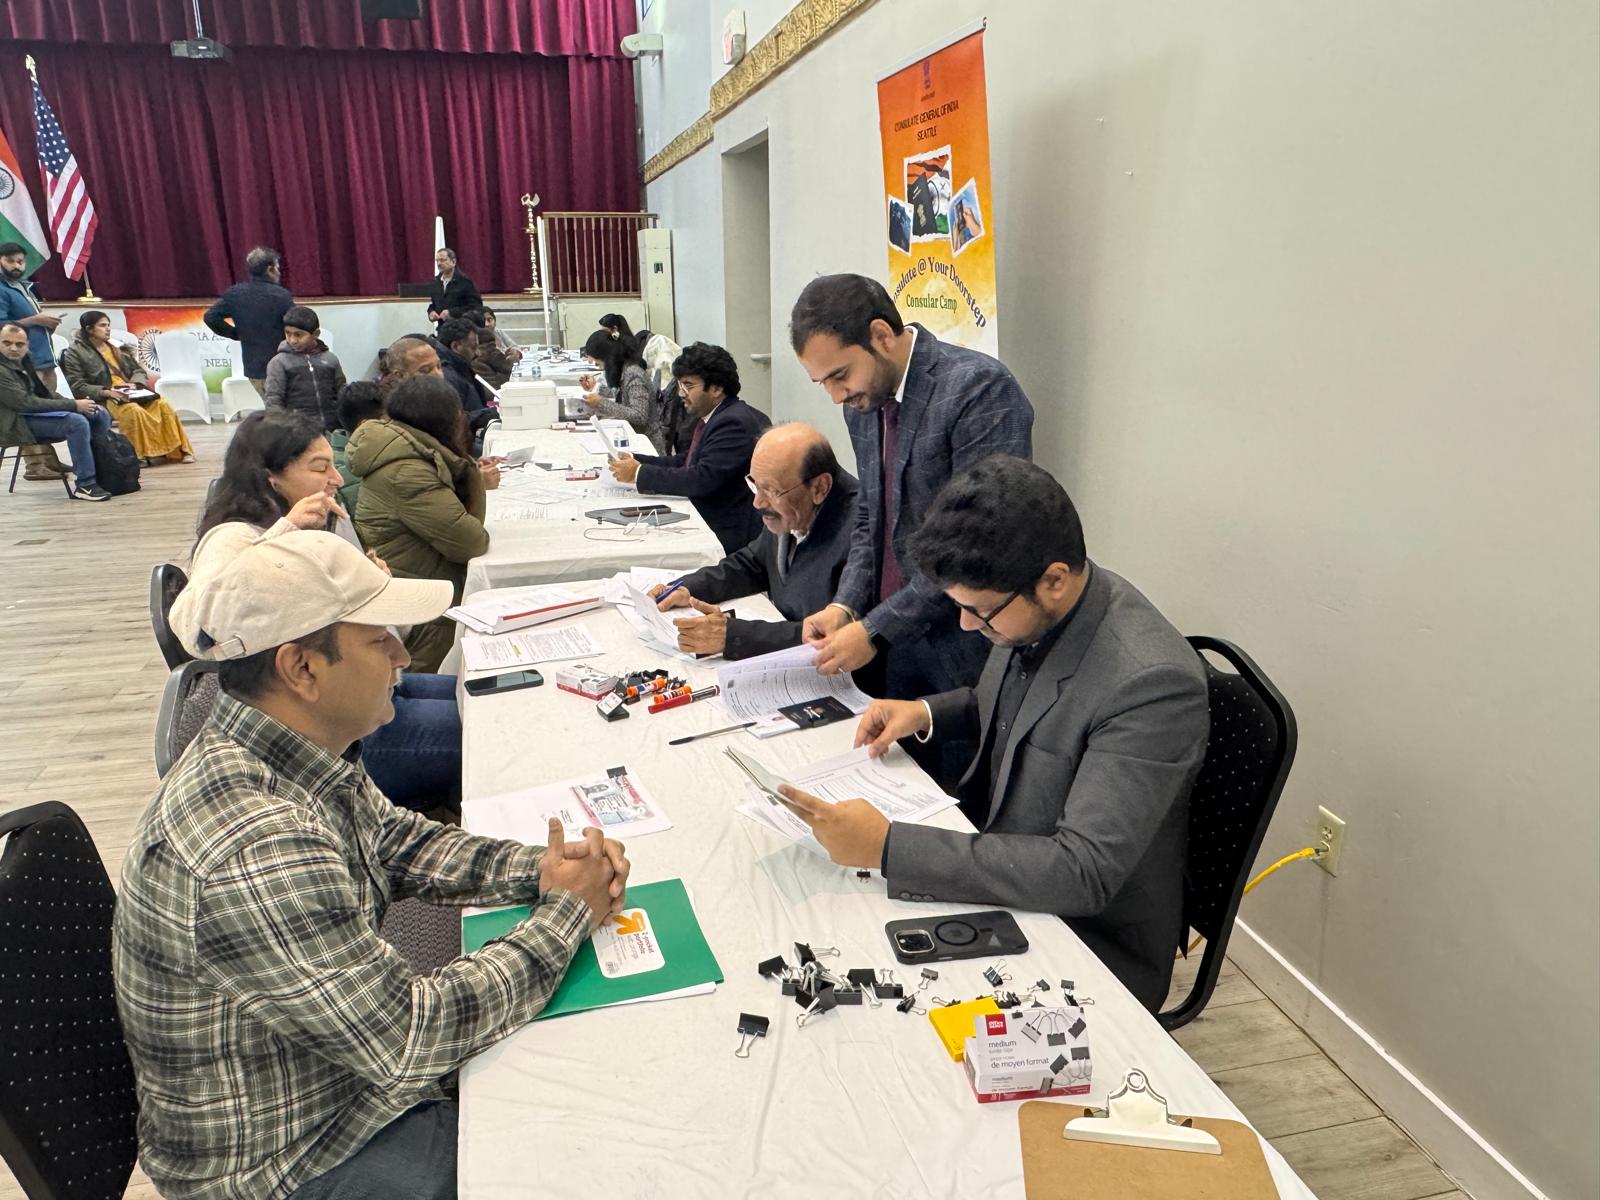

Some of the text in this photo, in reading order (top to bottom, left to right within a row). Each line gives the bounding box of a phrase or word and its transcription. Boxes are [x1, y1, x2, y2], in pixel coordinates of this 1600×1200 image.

[894, 114, 919, 132] CONSULATE
[920, 108, 941, 125] GENERAL
[946, 100, 959, 114] INDIA
[917, 126, 937, 141] SEATTLE
[918, 258, 927, 275] @
[928, 257, 949, 277] Your
[949, 264, 987, 328] Doorstep
[906, 293, 958, 313] Consular Camp
[988, 1039, 1017, 1048] medium
[1001, 1060, 1026, 1069] moyen
[1026, 1057, 1050, 1066] format
